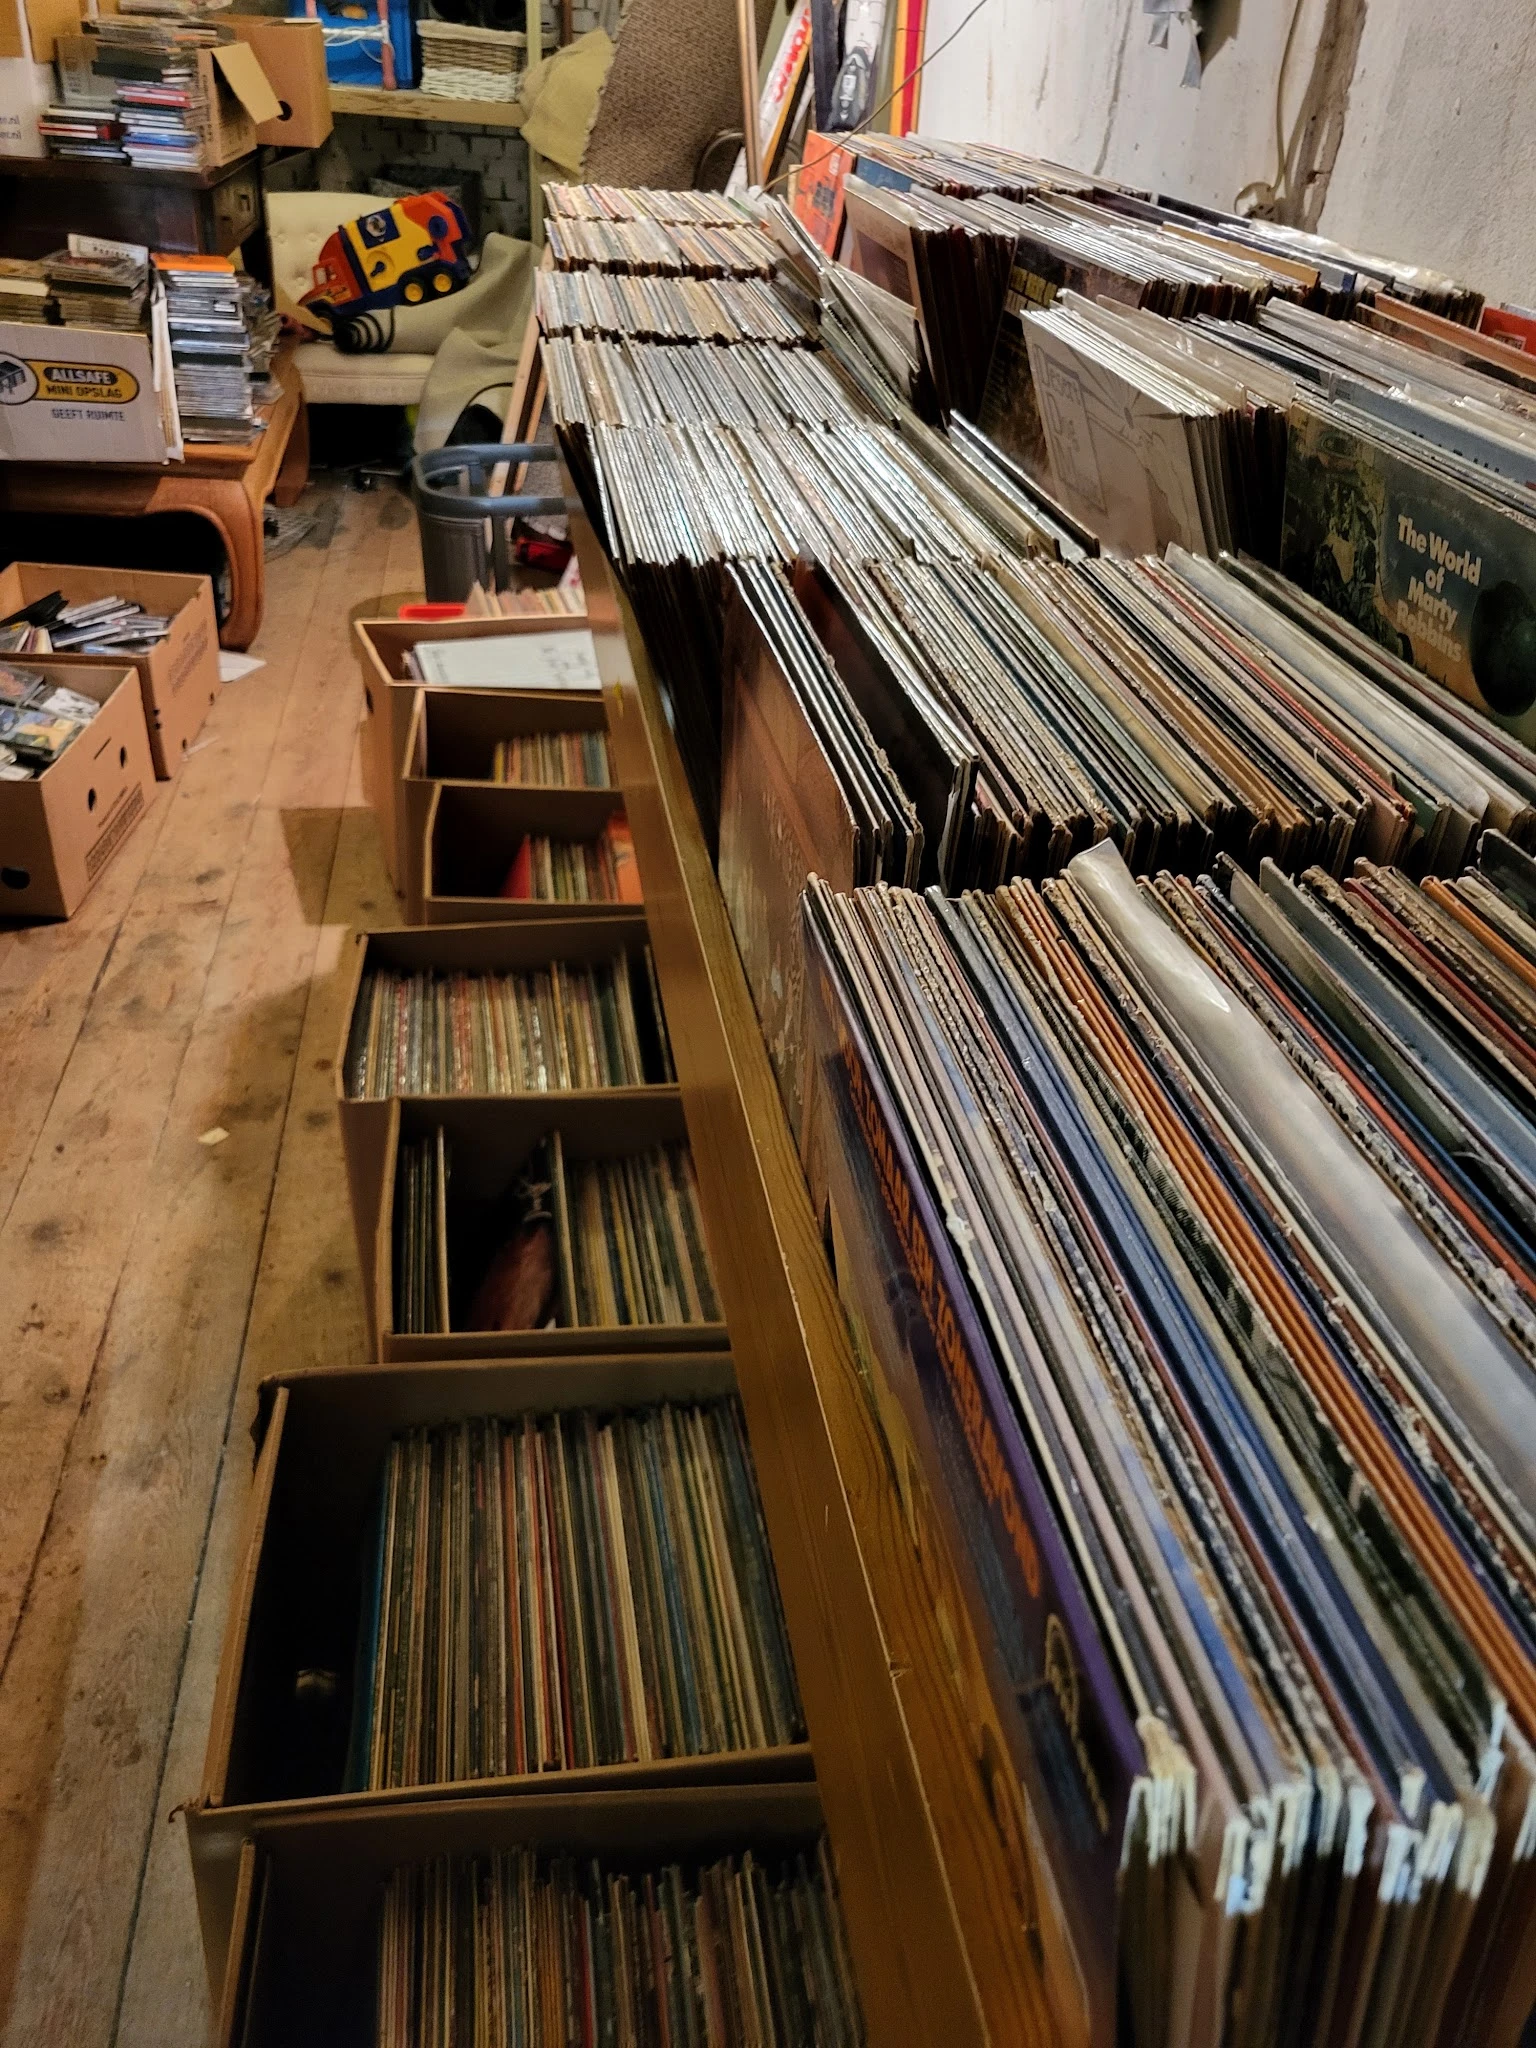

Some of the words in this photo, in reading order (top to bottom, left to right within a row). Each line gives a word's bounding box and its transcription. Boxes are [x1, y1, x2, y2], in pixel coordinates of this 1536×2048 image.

[47, 385, 73, 396] MINI
[76, 386, 123, 398] OPSLAG
[52, 368, 112, 385] ALLSAFE
[1397, 513, 1427, 554] The
[1429, 531, 1482, 587] World
[1425, 567, 1446, 594] of
[1407, 575, 1458, 632] Marty
[1396, 598, 1462, 663] Robbins
